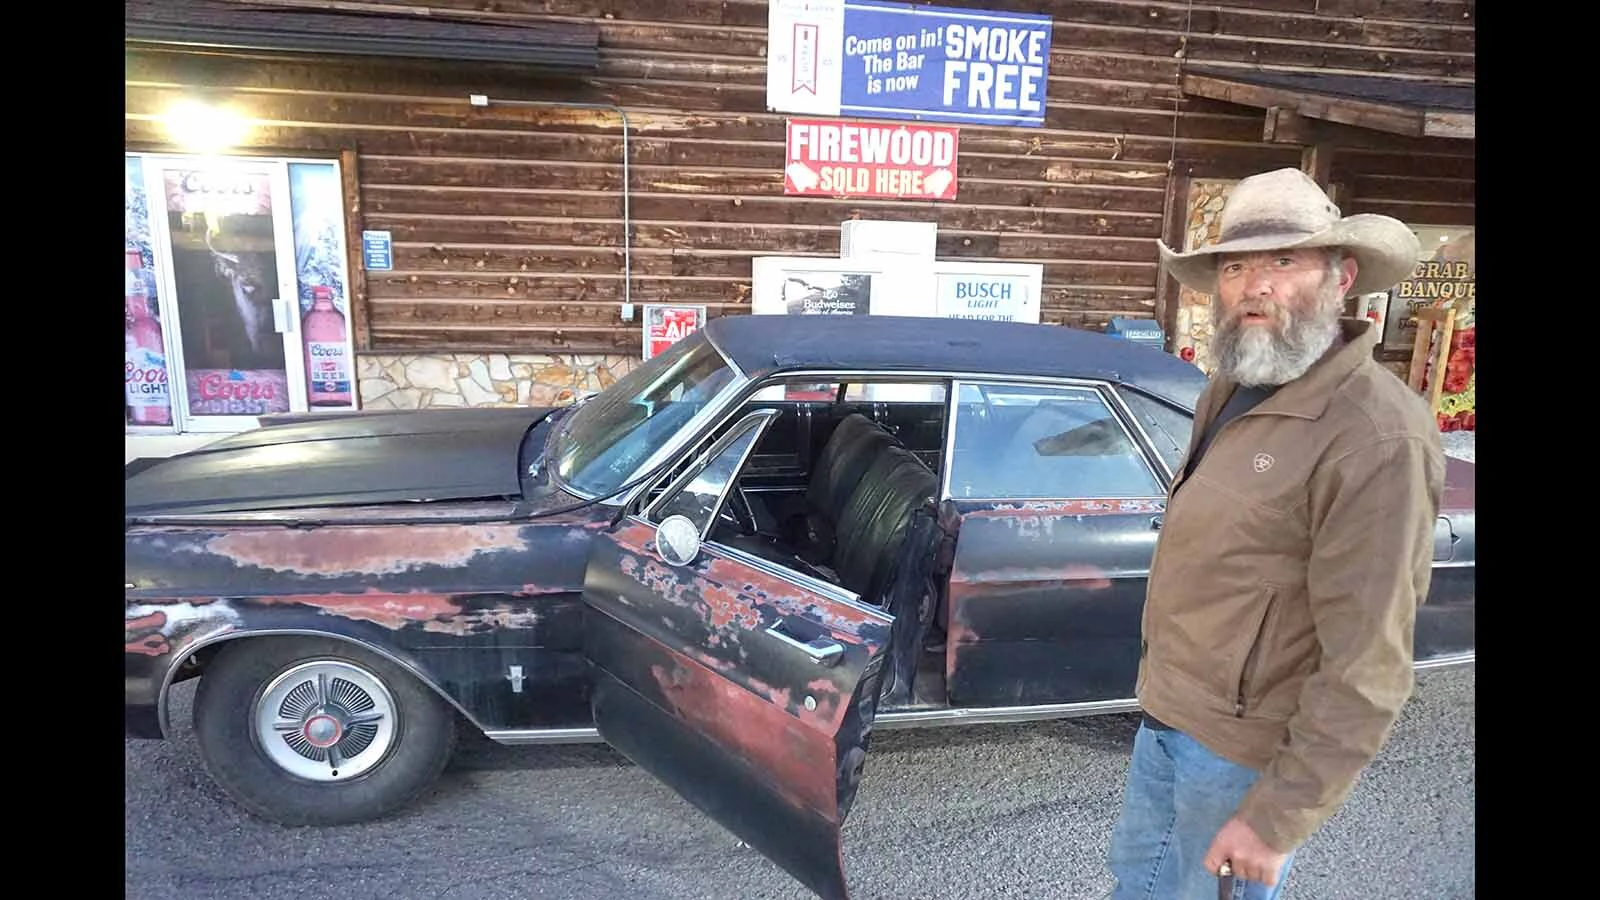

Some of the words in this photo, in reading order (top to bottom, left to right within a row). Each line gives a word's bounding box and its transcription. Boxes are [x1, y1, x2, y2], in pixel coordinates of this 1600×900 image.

[845, 35, 892, 56] Come
[896, 34, 916, 51] on
[920, 27, 943, 49] in!
[944, 24, 1046, 65] SMOKE
[863, 54, 893, 75] The
[896, 51, 926, 71] Bar
[866, 75, 882, 95] is
[885, 75, 919, 93] now
[943, 60, 1043, 112] FREE
[791, 124, 954, 167] FIREWOOD
[820, 166, 870, 195] SOLD
[875, 168, 924, 195] HERE
[1411, 261, 1469, 279] GRAB
[956, 281, 1011, 300] BUSCH
[803, 298, 857, 310] Budweiser
[967, 299, 1000, 309] LIGHT
[311, 343, 344, 357] Coors
[129, 383, 168, 394] LIGHT
[199, 370, 275, 400] Coors
